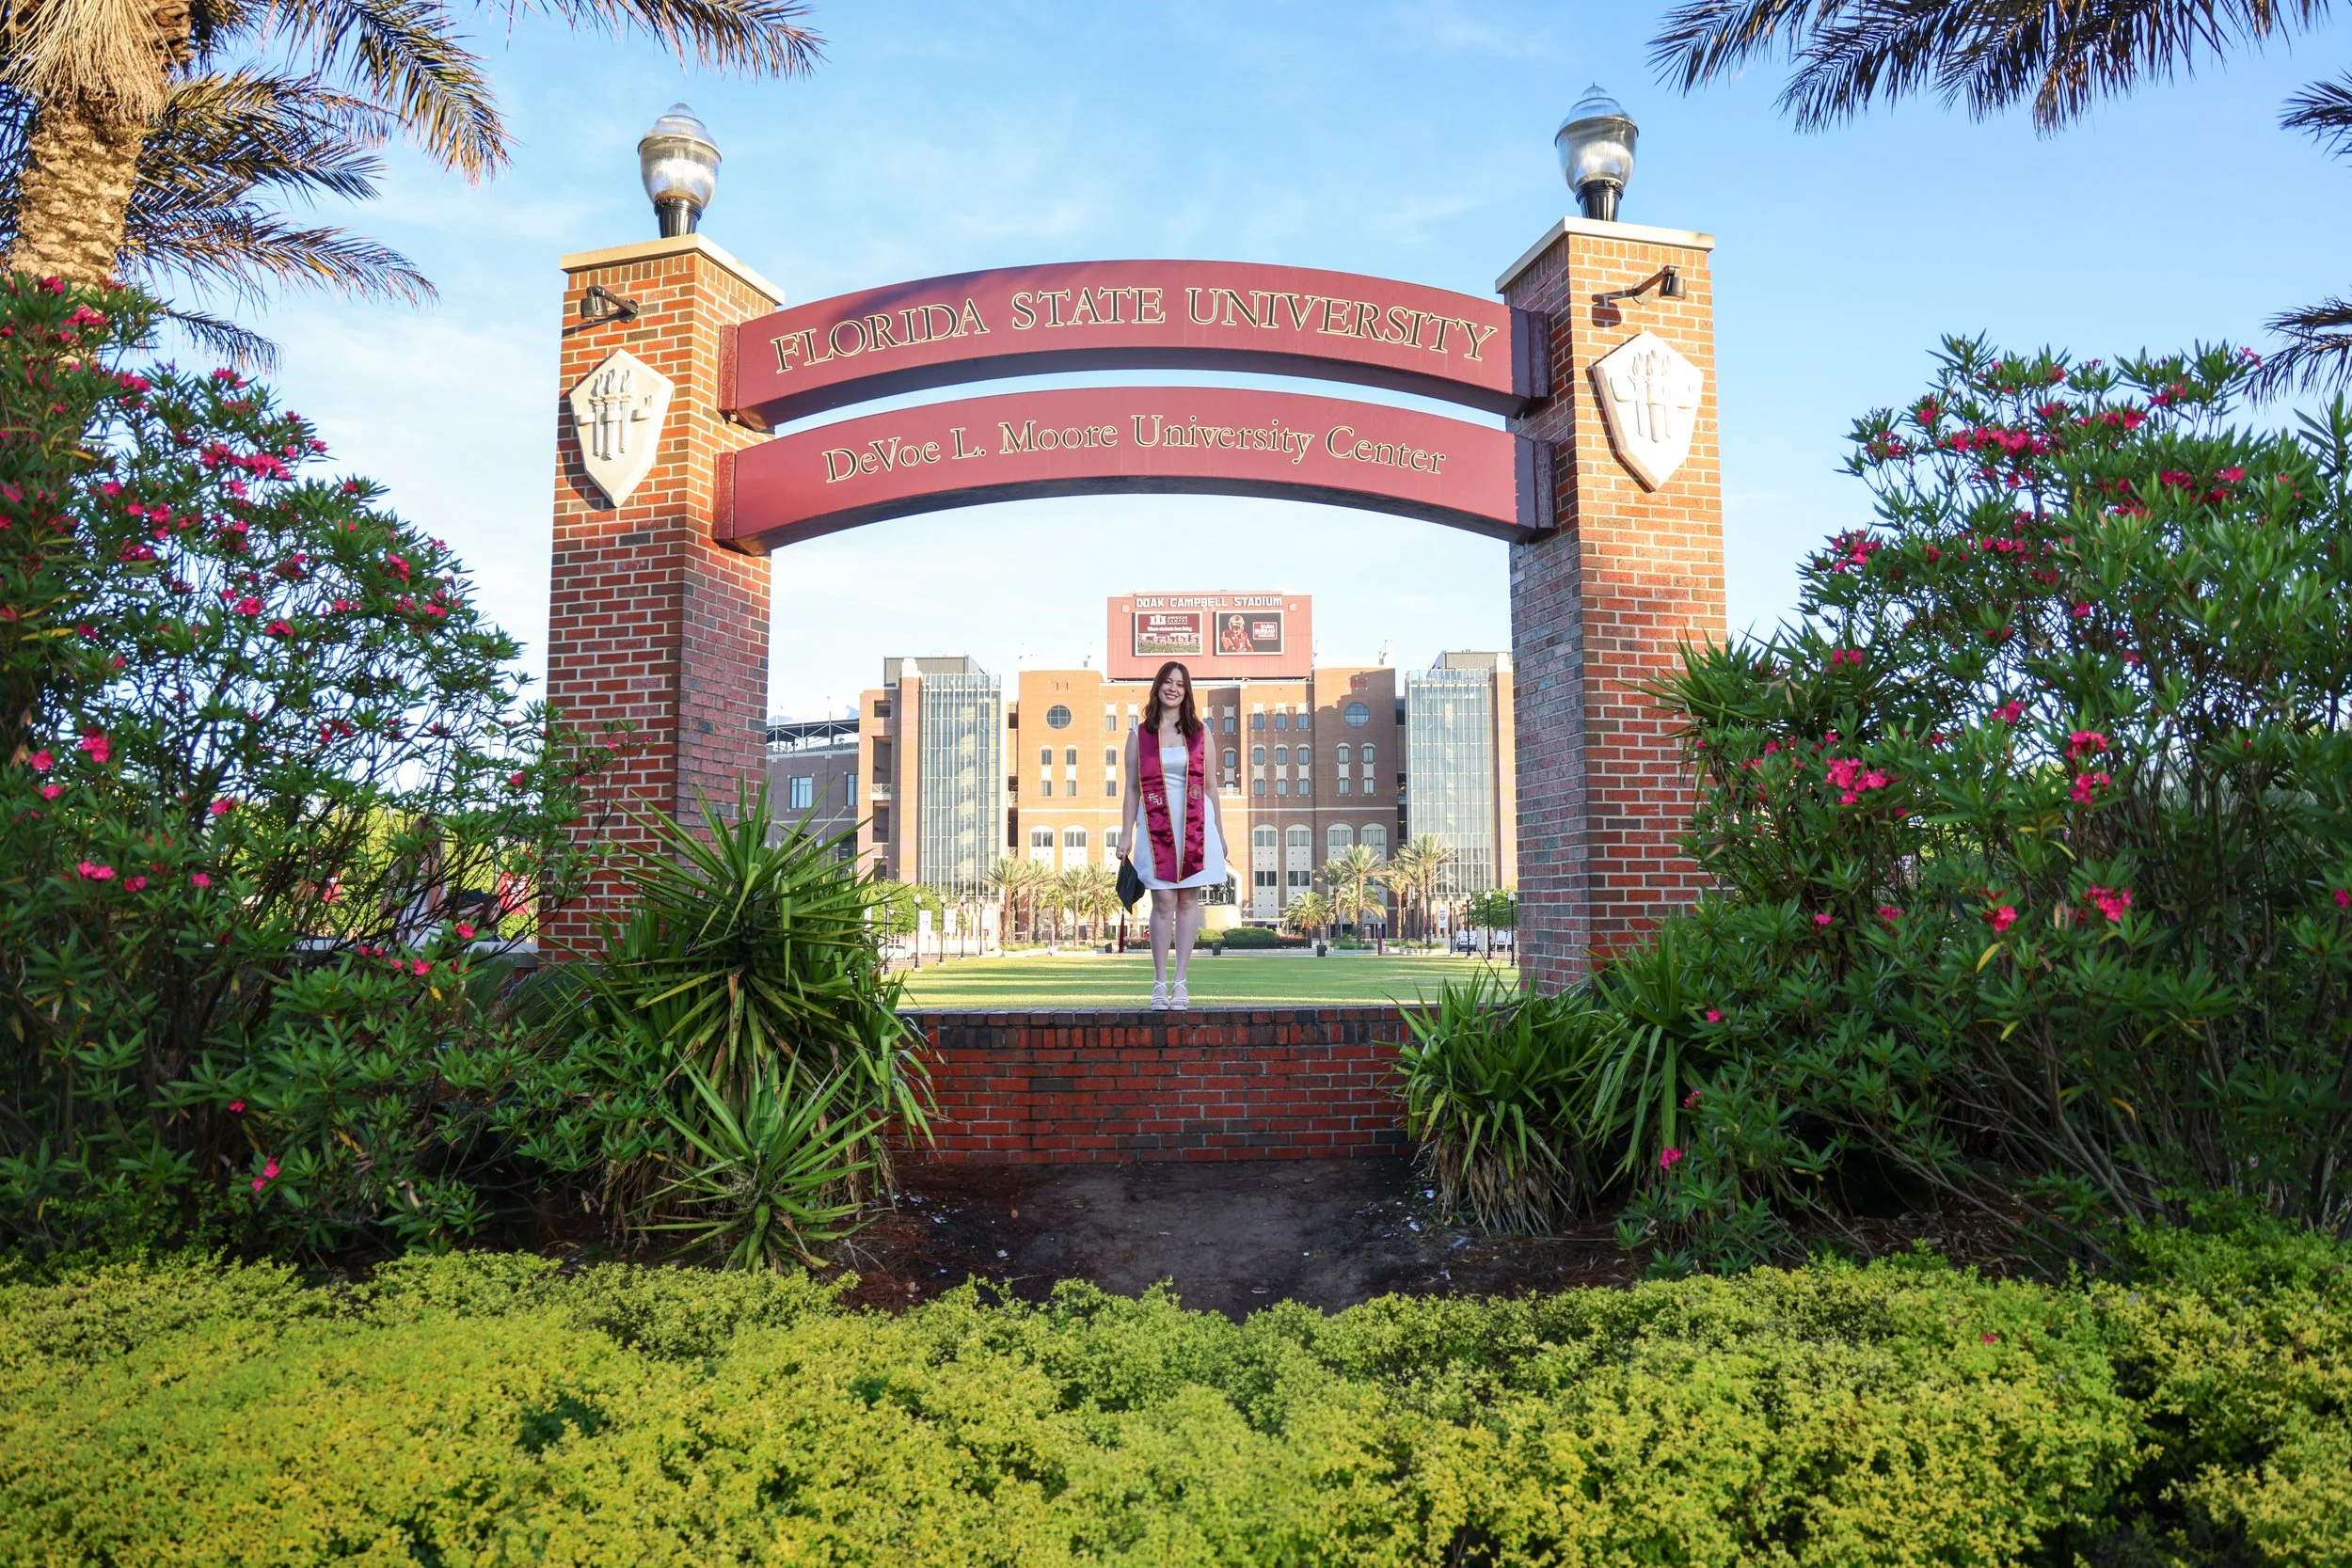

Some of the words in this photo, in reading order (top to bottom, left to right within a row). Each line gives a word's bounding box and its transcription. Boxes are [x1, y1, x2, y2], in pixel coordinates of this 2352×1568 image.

[770, 298, 991, 374] FLORIDA
[1011, 286, 1166, 331] STATE
[1185, 288, 1498, 361] UNIVERSITY
[821, 436, 941, 483] DeVoe
[950, 427, 987, 460] L.
[998, 420, 1119, 454] Moore
[1131, 414, 1315, 465] University
[1326, 425, 1446, 474] Center
[1136, 597, 1165, 608] DOAK
[1169, 596, 1228, 608] CAMPBELL
[1233, 596, 1282, 607] STADIUM
[1148, 793, 1163, 805] FSU
